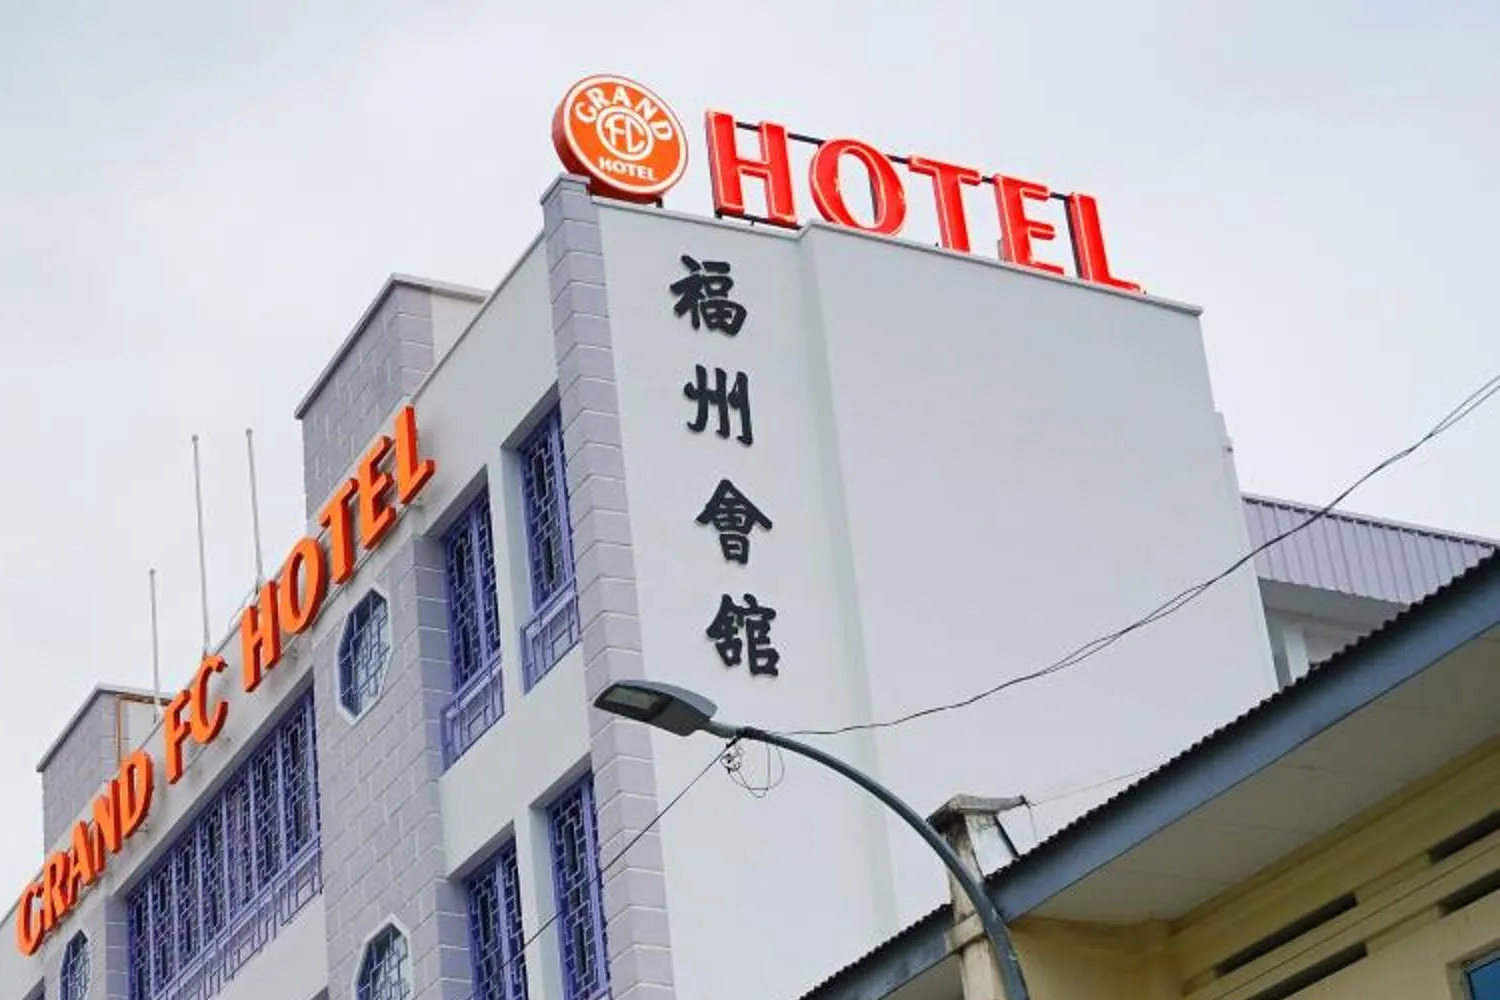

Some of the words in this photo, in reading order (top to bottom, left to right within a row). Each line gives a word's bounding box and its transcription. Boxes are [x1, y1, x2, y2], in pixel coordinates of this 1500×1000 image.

[575, 87, 673, 140] GRAND
[599, 157, 655, 179] HOTEL
[705, 109, 1141, 292] HOTEL
[16, 750, 154, 956] GRAND
[162, 654, 229, 785] FC
[240, 404, 435, 692] HOTEL
